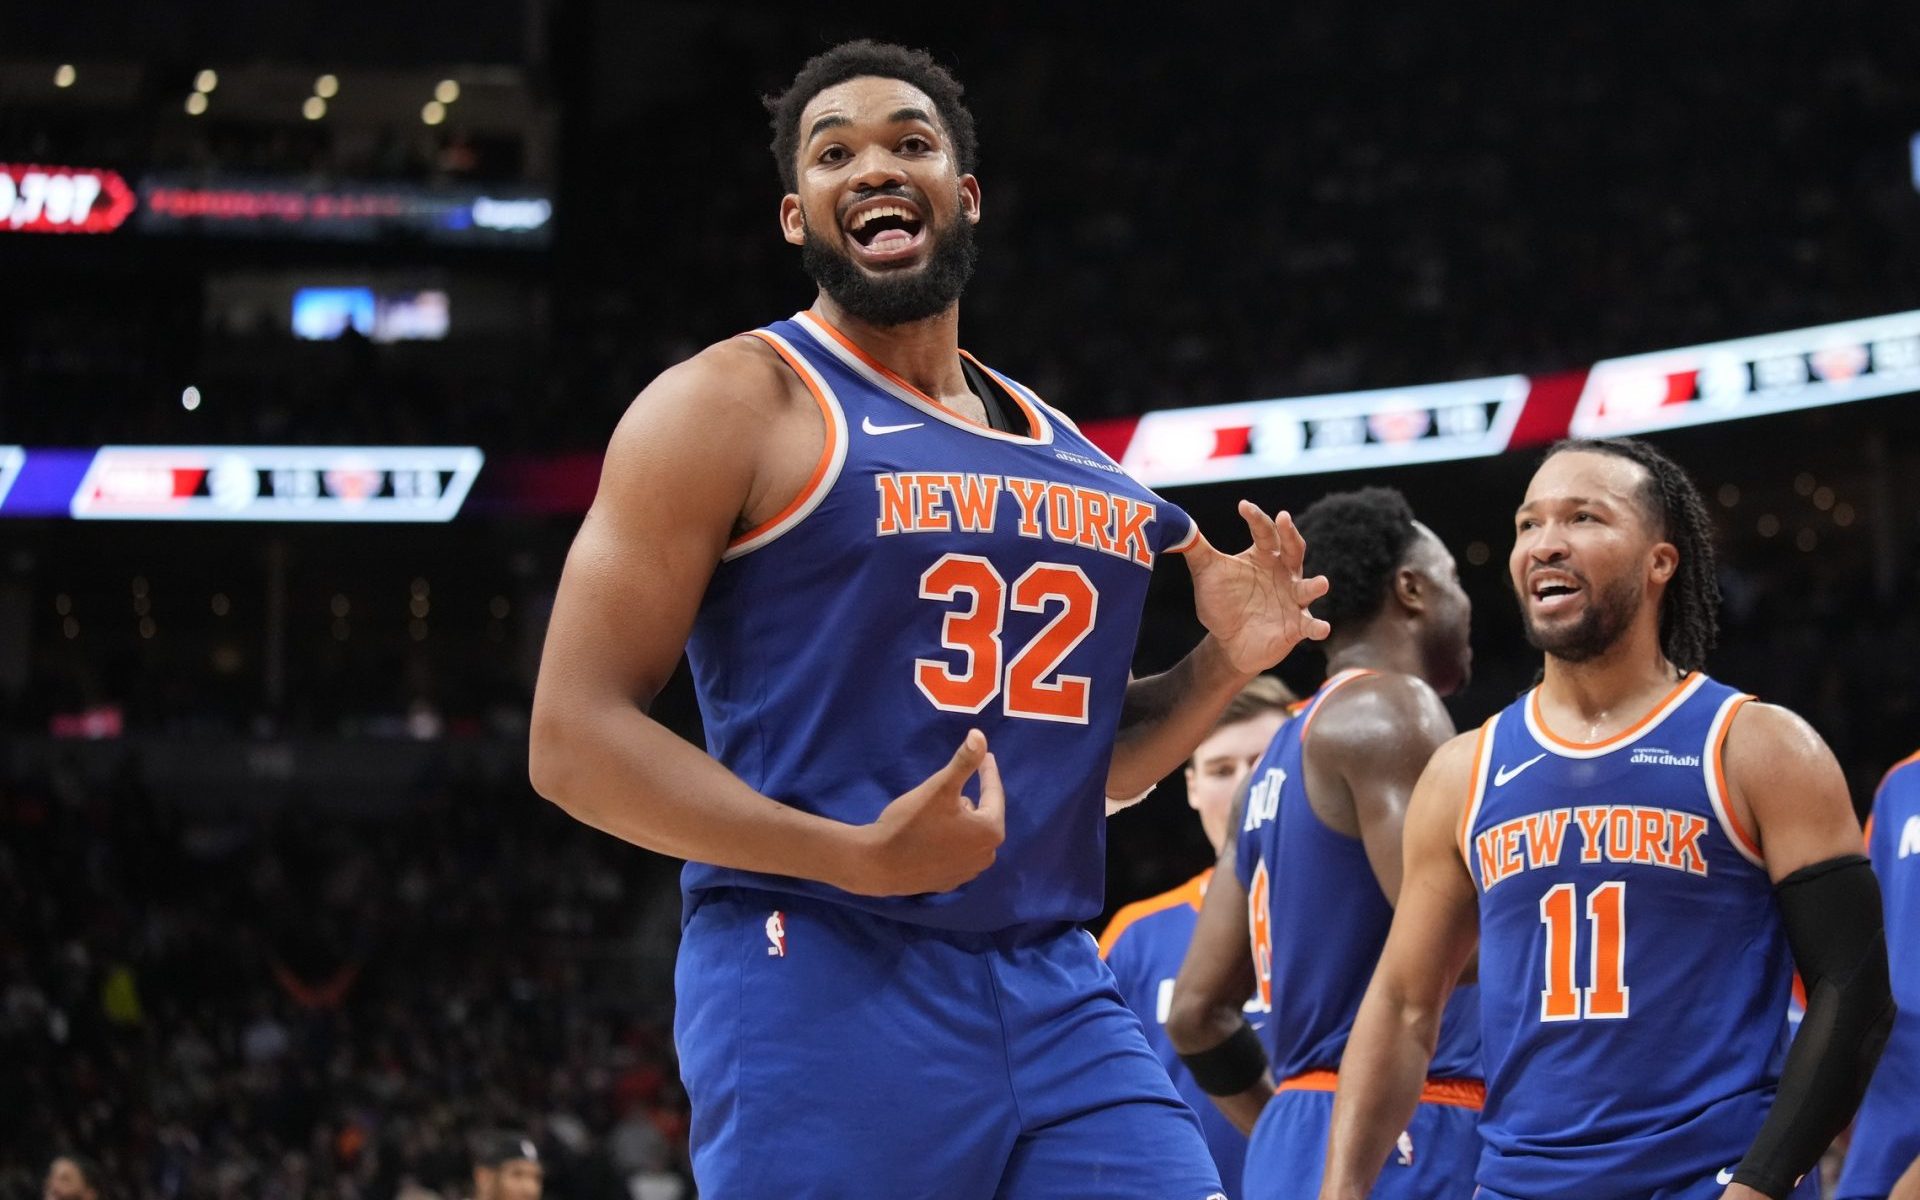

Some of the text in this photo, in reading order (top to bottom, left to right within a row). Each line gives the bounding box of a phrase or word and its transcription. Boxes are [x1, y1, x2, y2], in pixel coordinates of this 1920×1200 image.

[875, 472, 1156, 571] NEW YORK
[914, 553, 1099, 724] 32
[1630, 754, 1700, 767] abu dhabi
[1476, 804, 1708, 893] NEW YORK
[1540, 881, 1629, 1022] 11
